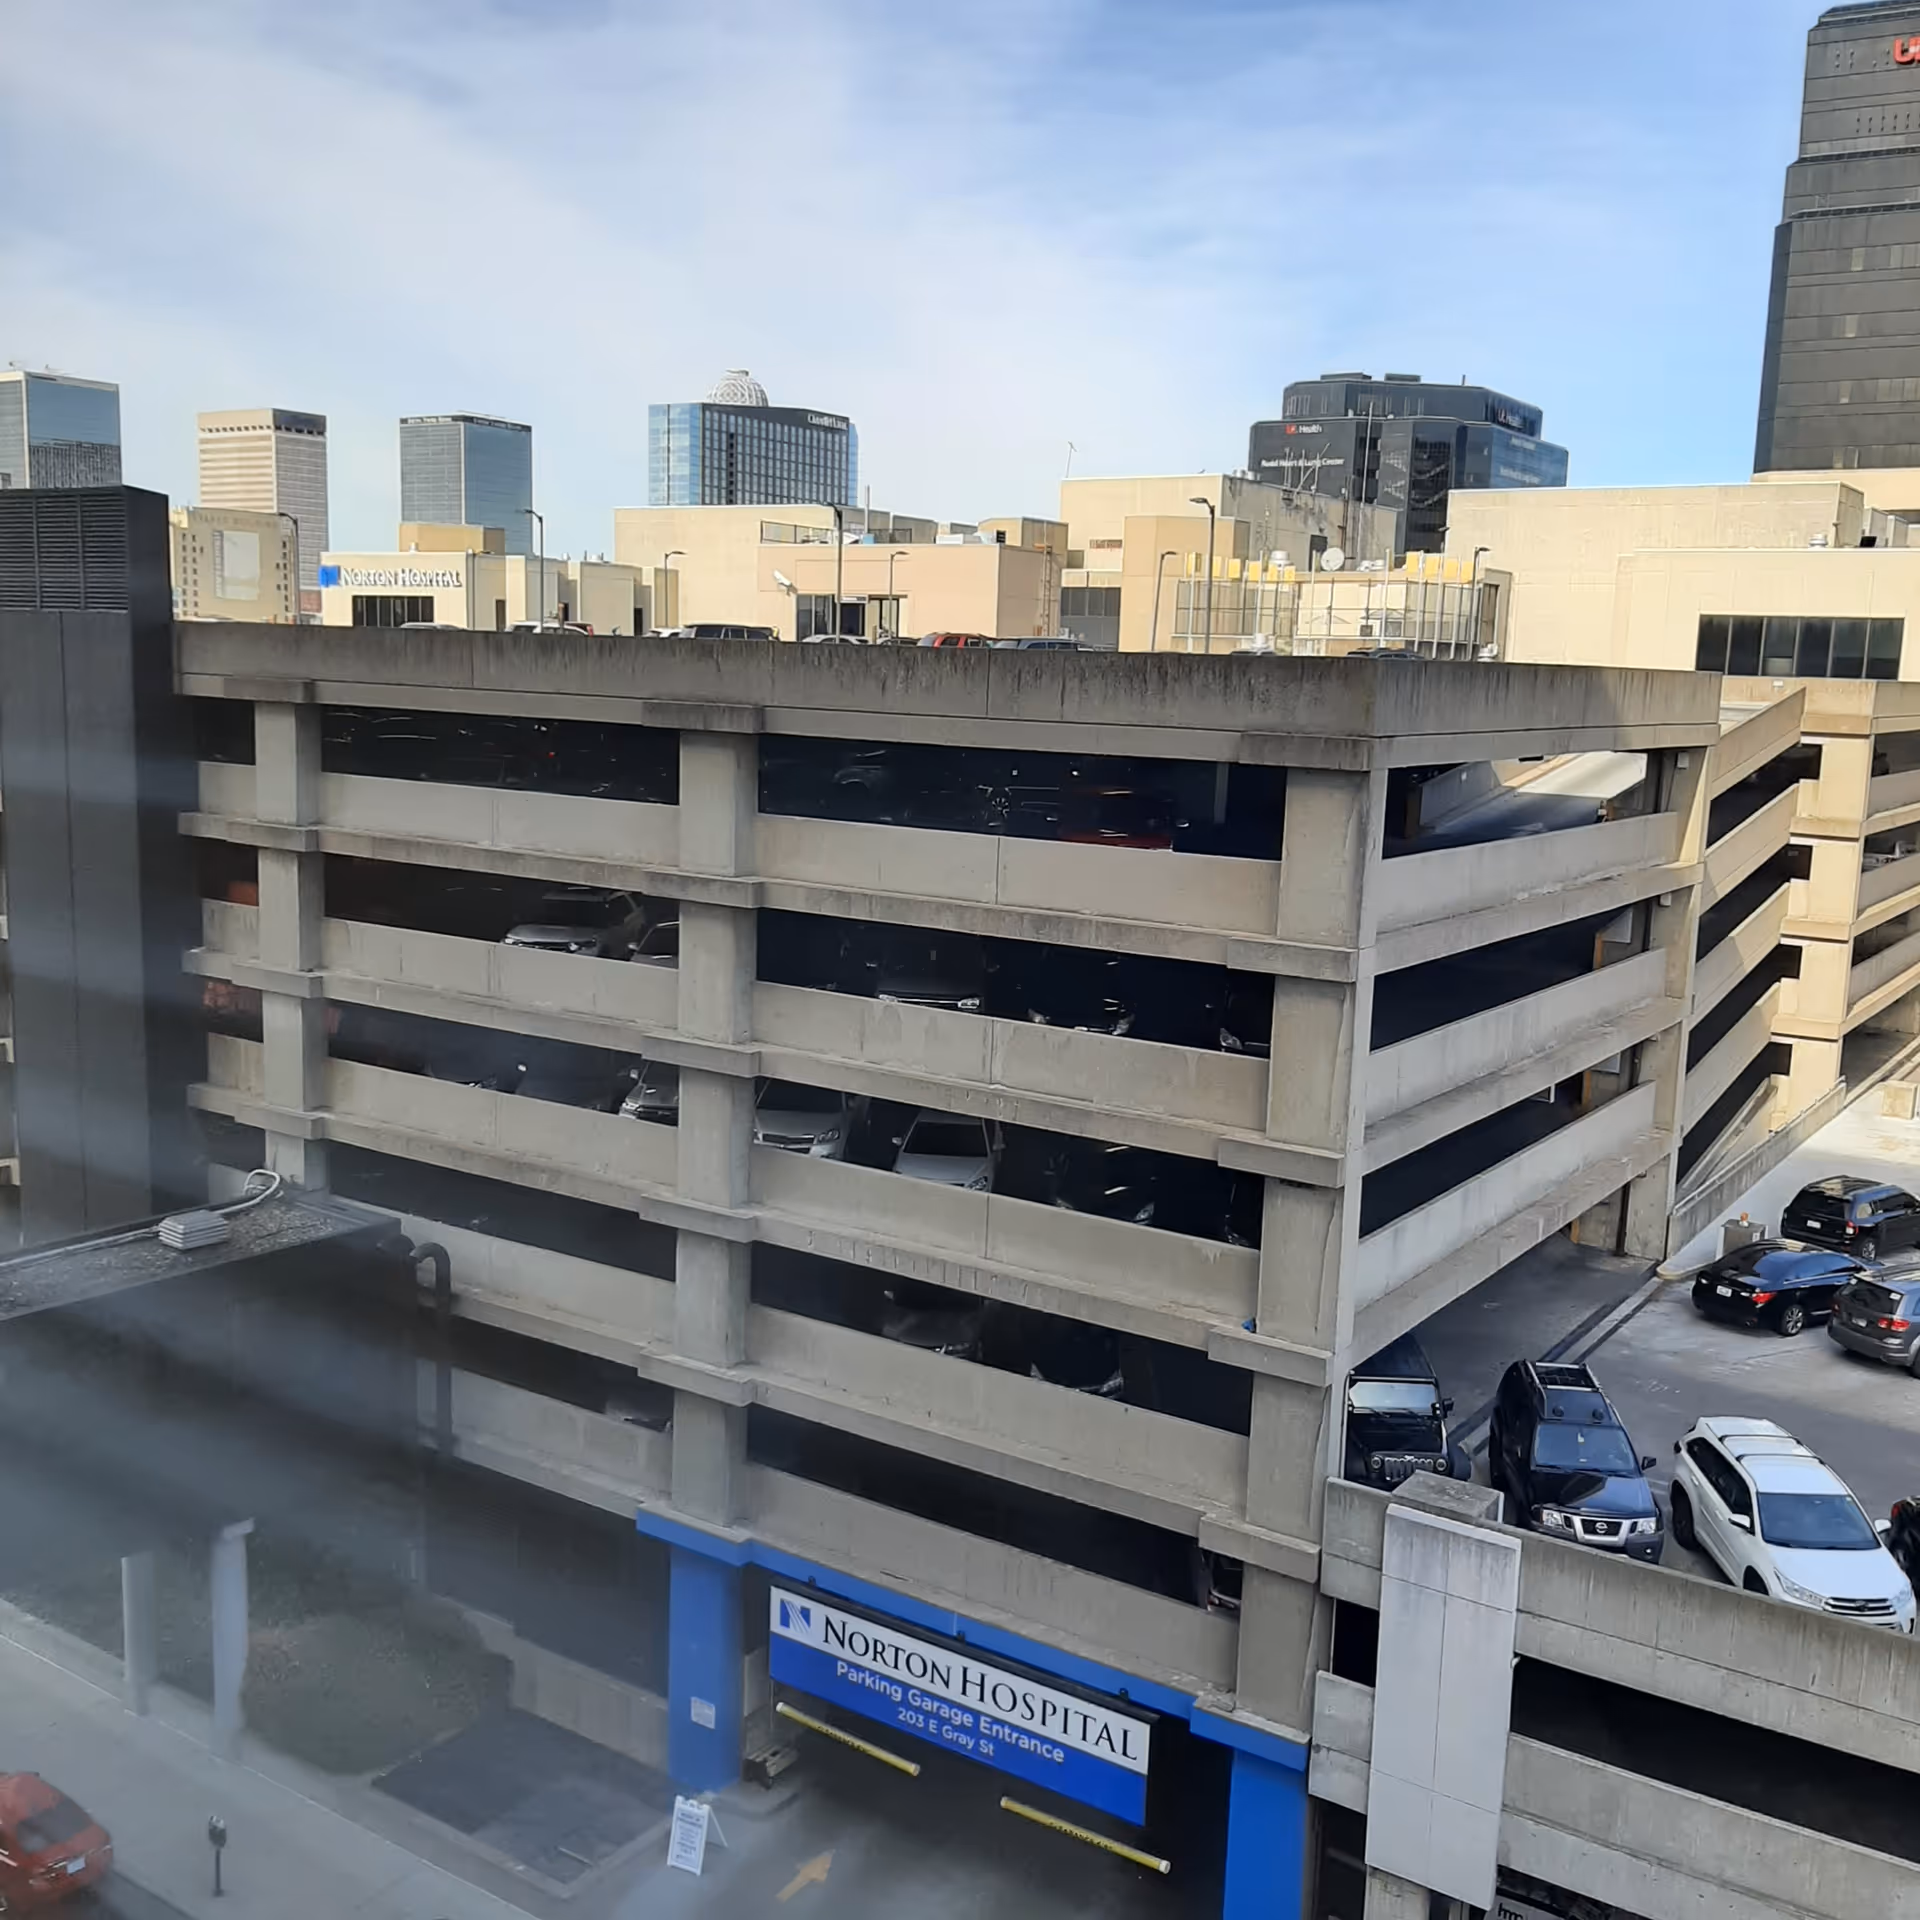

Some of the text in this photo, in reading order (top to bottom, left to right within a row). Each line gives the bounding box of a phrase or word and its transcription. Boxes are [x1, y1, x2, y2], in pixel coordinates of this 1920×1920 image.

[341, 567, 463, 587] NORTON HOSPITAL
[822, 1614, 952, 1690] NORTON
[960, 1665, 1138, 1761] HOSPITAL
[837, 1660, 1065, 1764] Parking Garage Entrance
[898, 1707, 995, 1757] 203 E Gray St
